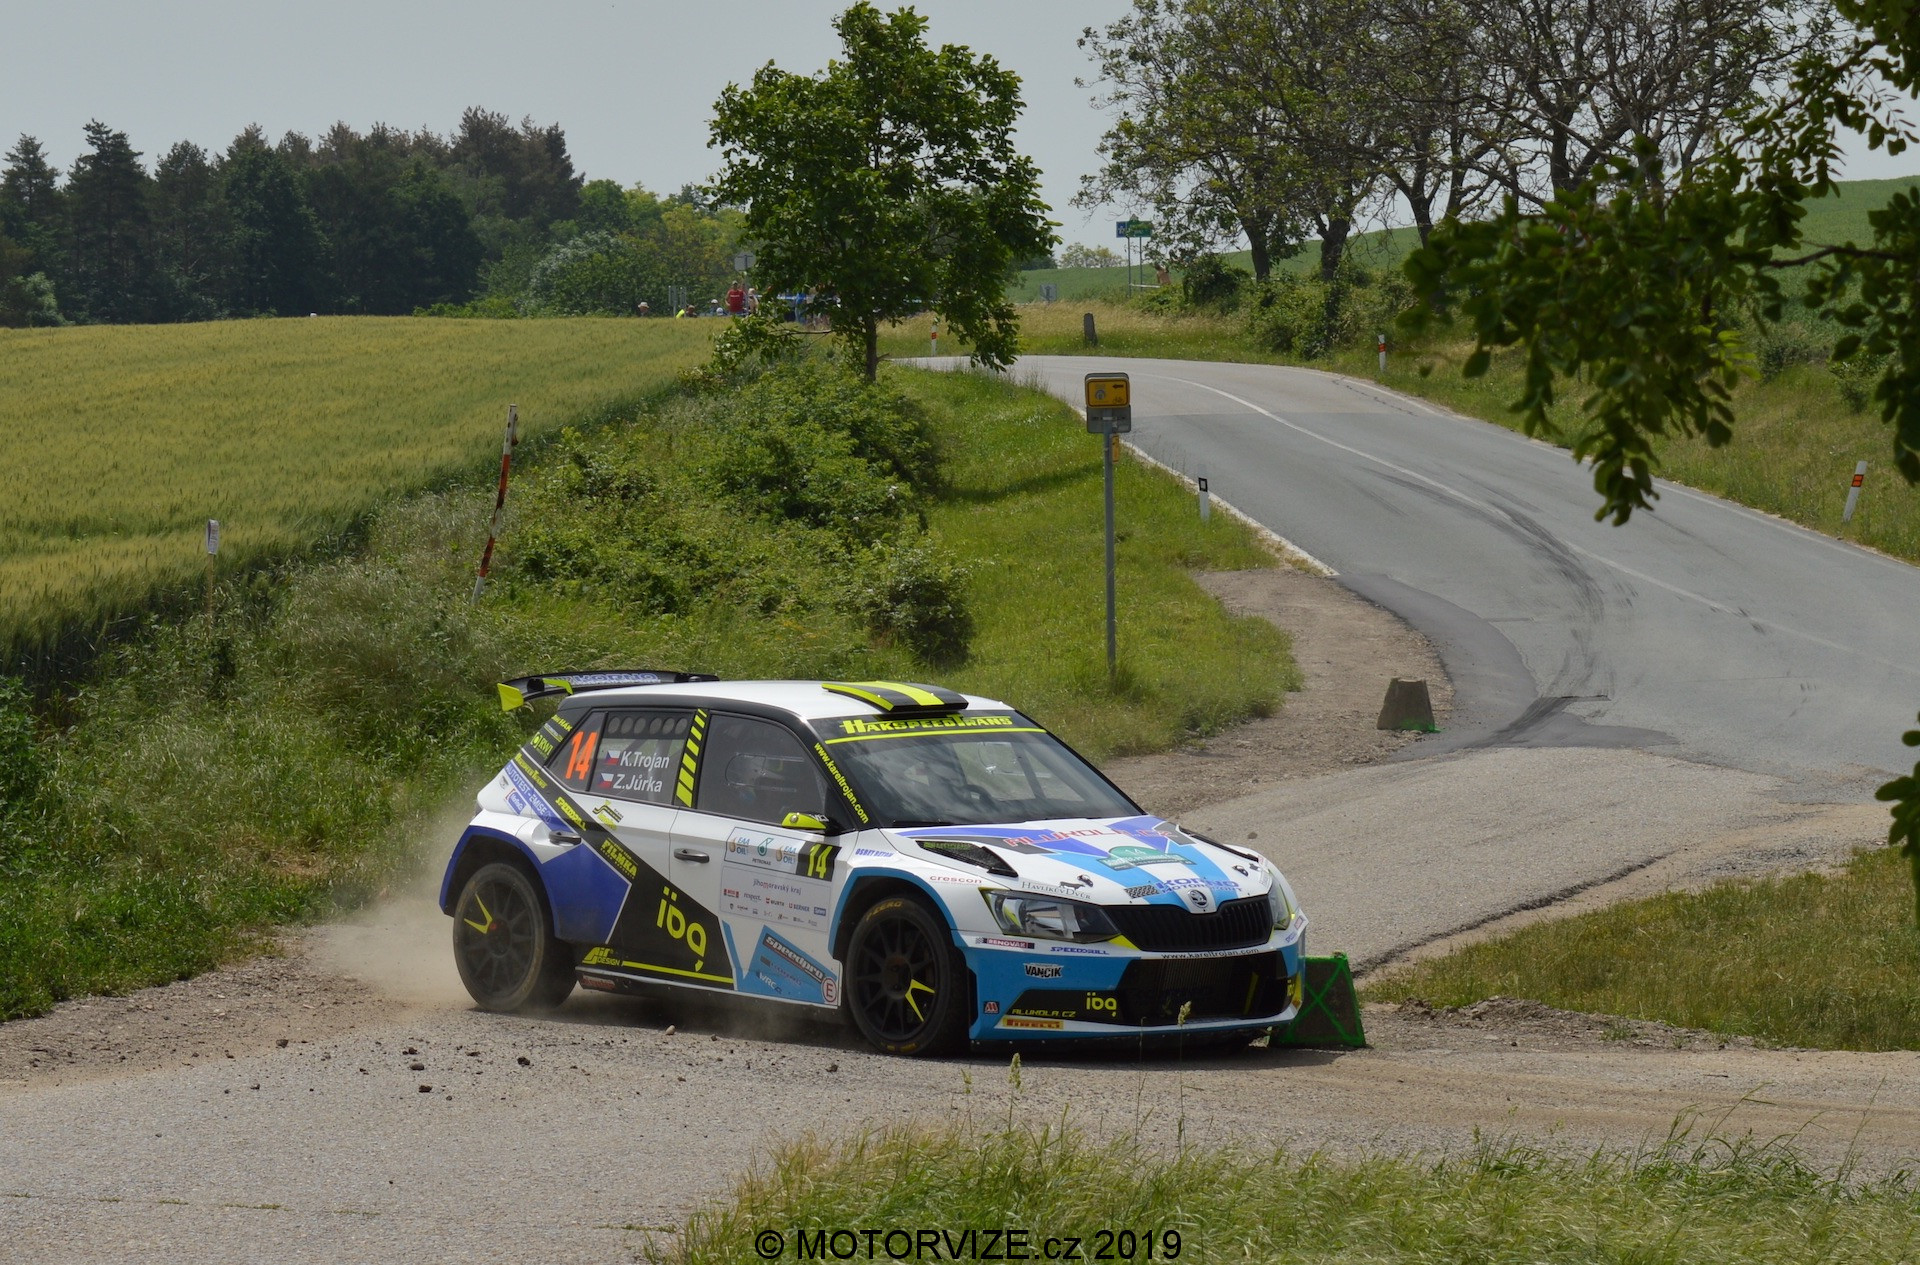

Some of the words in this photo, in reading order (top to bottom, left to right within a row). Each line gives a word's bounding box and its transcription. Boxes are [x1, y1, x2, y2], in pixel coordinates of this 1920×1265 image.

[565, 731, 598, 780] 14
[619, 750, 670, 771] K.Trojan
[505, 764, 530, 794] AUTOTEST
[612, 774, 663, 793] Z.Jůrka
[814, 742, 869, 824] www.kareltrojan.com
[807, 844, 833, 879] 14
[929, 876, 982, 884] crescon
[790, 886, 802, 896] kraj
[765, 935, 824, 982] speedpro
[1161, 948, 1259, 960] www.kareltrojan.com
[826, 984, 834, 997] E
